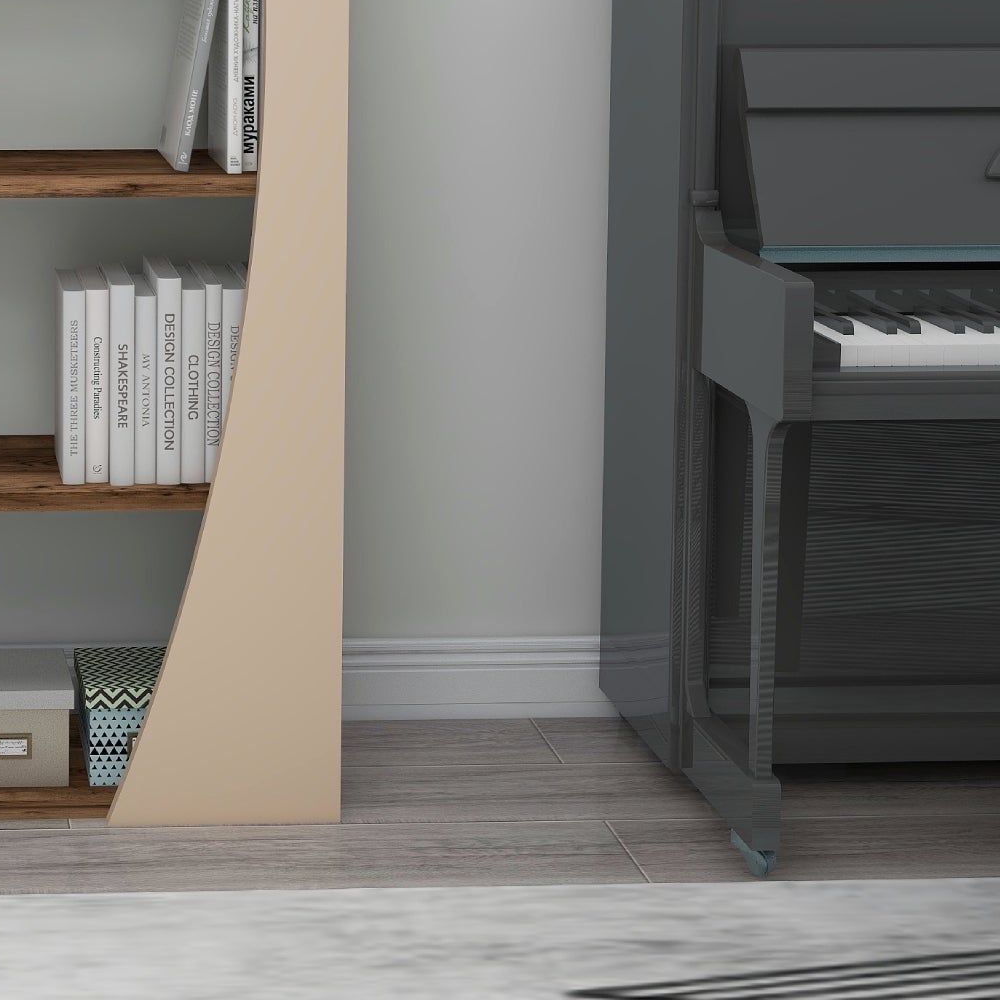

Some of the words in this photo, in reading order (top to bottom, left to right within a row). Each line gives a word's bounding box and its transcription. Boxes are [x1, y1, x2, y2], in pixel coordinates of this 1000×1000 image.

[243, 76, 257, 154] мураками
[70, 320, 79, 393] MUSKETEERS
[93, 336, 103, 385] Constructing
[142, 353, 150, 370] MY
[164, 314, 175, 362] DESIGN
[208, 322, 220, 371] DESIGN
[70, 395, 79, 432] THREE
[118, 344, 128, 429] SHAKESPEARE
[164, 364, 175, 451] COLLECTION
[188, 355, 198, 420] CLOTHING
[207, 372, 220, 446] COLLECTION
[70, 434, 79, 456] THE
